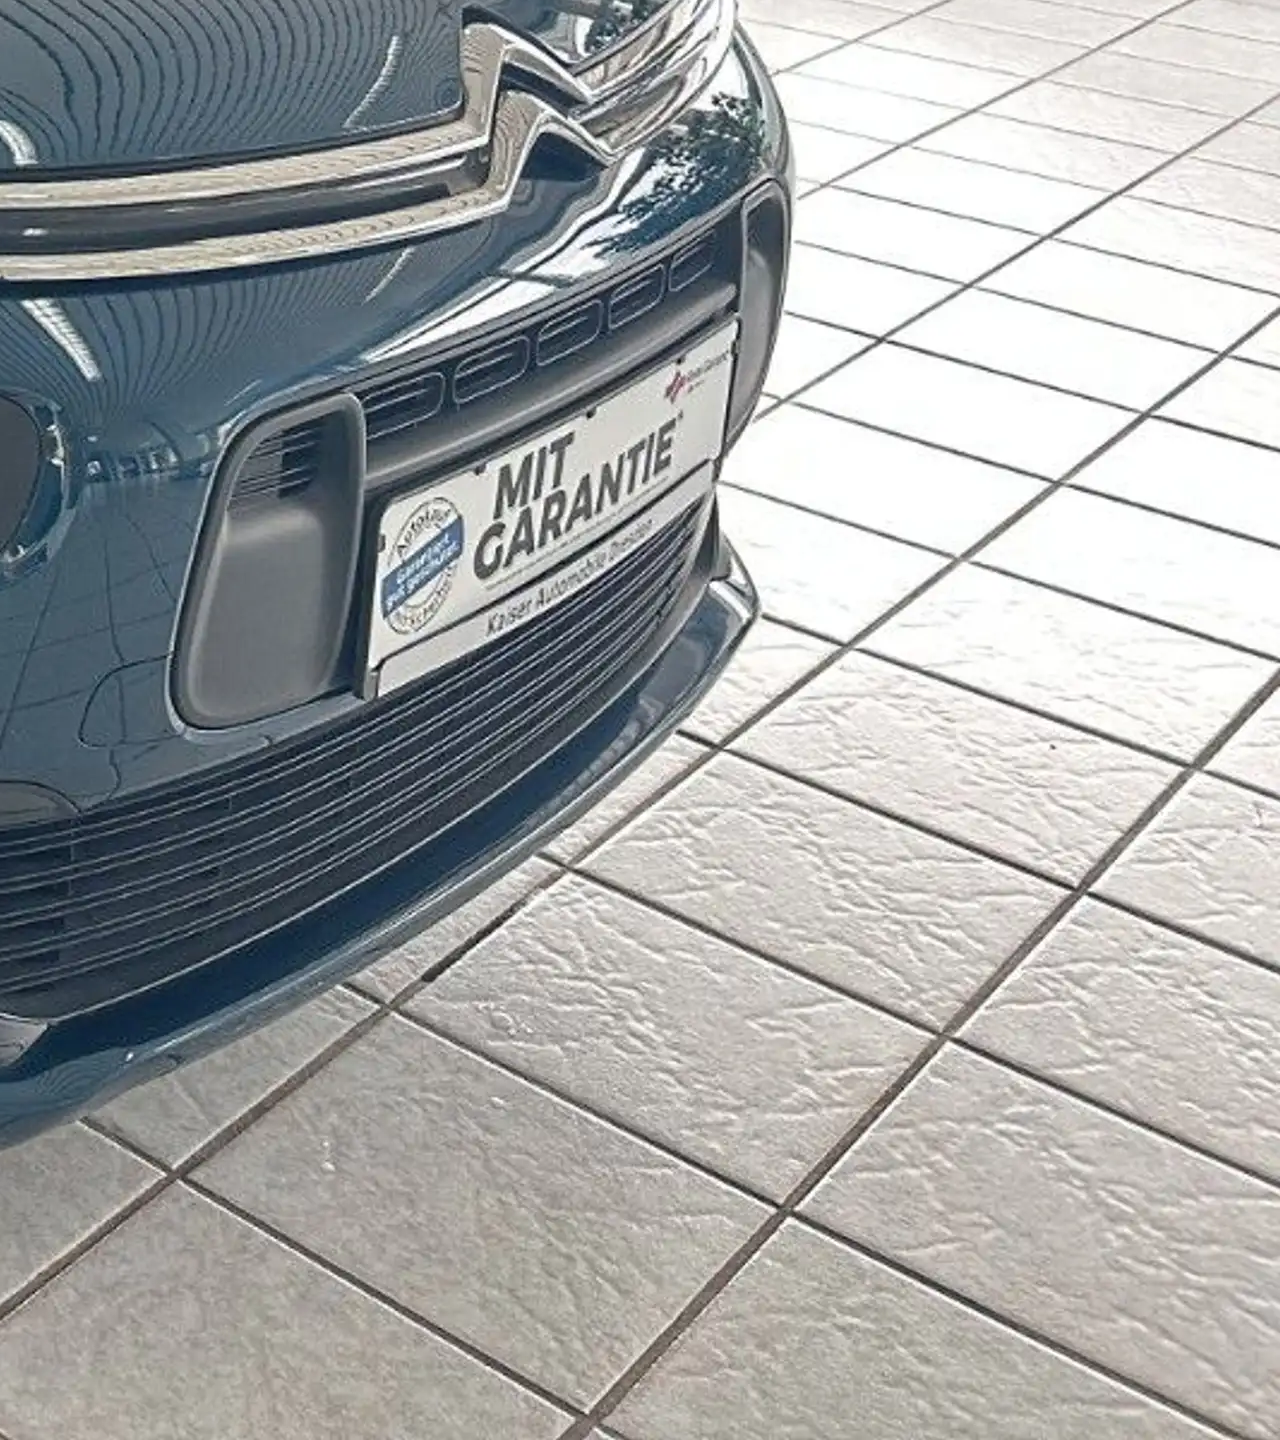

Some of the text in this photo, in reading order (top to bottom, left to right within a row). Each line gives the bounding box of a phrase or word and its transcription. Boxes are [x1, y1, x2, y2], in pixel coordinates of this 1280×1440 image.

[473, 417, 677, 580] GARANTIE
[493, 431, 575, 520] MIT
[487, 599, 533, 636] Kaiser
